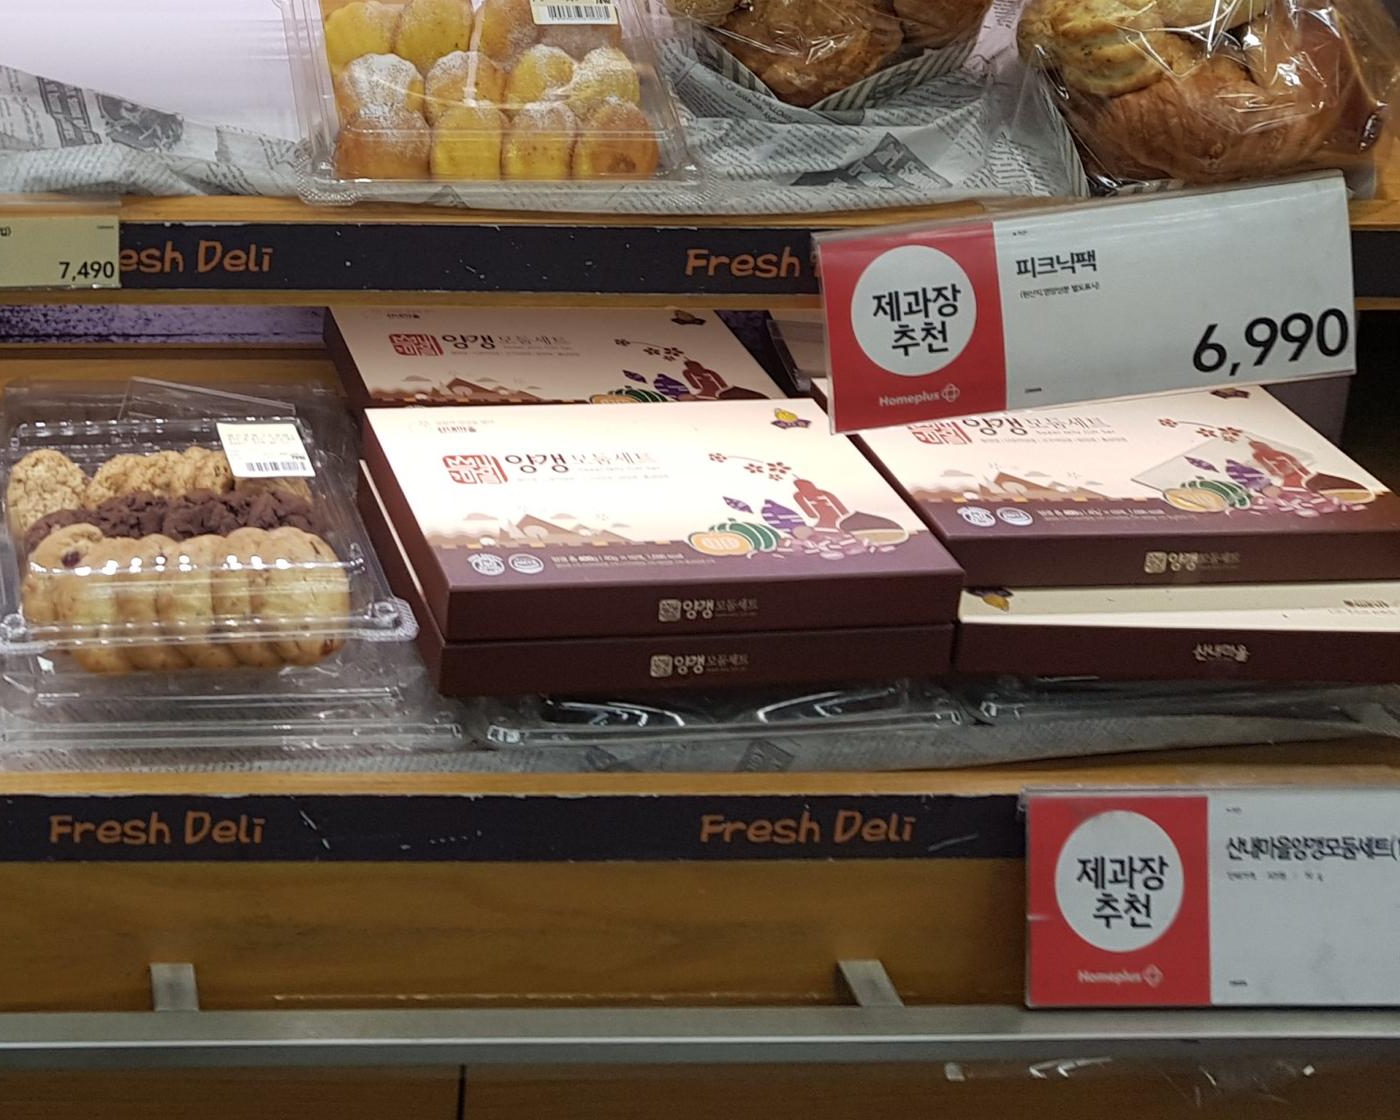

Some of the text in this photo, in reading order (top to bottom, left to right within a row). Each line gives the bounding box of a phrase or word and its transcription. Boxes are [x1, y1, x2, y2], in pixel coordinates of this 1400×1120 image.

[58, 260, 115, 282] 7,490
[118, 240, 273, 273] esh Deli
[685, 246, 800, 278] Fresh
[1016, 249, 1098, 279] 피크닉팩
[872, 282, 962, 324] 제과장
[891, 322, 950, 357] 추천
[1191, 307, 1349, 378] 6,990
[879, 389, 940, 407] Homeplus
[504, 453, 570, 474] 양갱
[682, 599, 715, 620] 양갱
[674, 653, 706, 675] 양갱
[49, 810, 265, 845] Fresh Deli
[700, 810, 914, 845] Fresh Deli
[1076, 855, 1170, 892] 제과장
[1092, 892, 1153, 929] 추천
